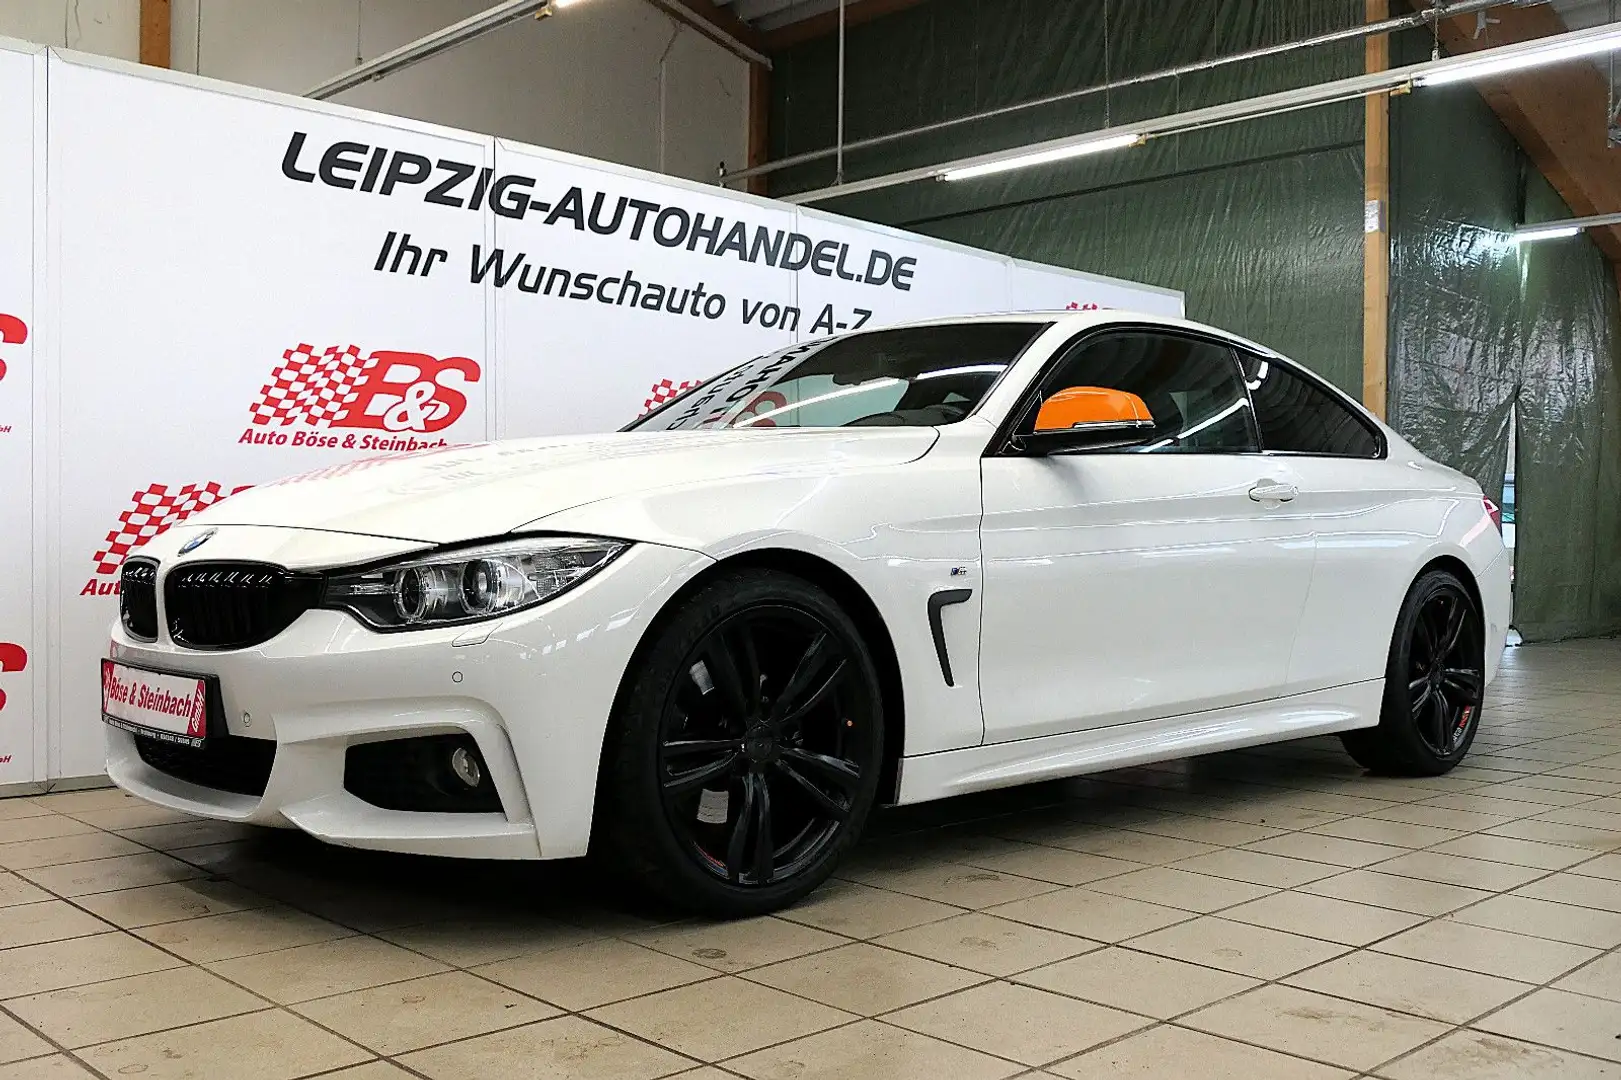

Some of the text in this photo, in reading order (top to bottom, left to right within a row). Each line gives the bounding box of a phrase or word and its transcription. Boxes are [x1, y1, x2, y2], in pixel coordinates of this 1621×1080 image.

[281, 131, 917, 291] LEIPZIG-AUTOHANDEL.DE
[373, 231, 448, 277] Ihr
[470, 244, 727, 320] Wunschauto
[742, 298, 801, 332] von
[329, 350, 481, 433] B&S
[238, 428, 288, 446] Auto
[291, 431, 339, 449] Böse
[341, 433, 357, 449] &
[80, 578, 122, 596] Aut
[109, 677, 193, 718] Böse & Steinbach
